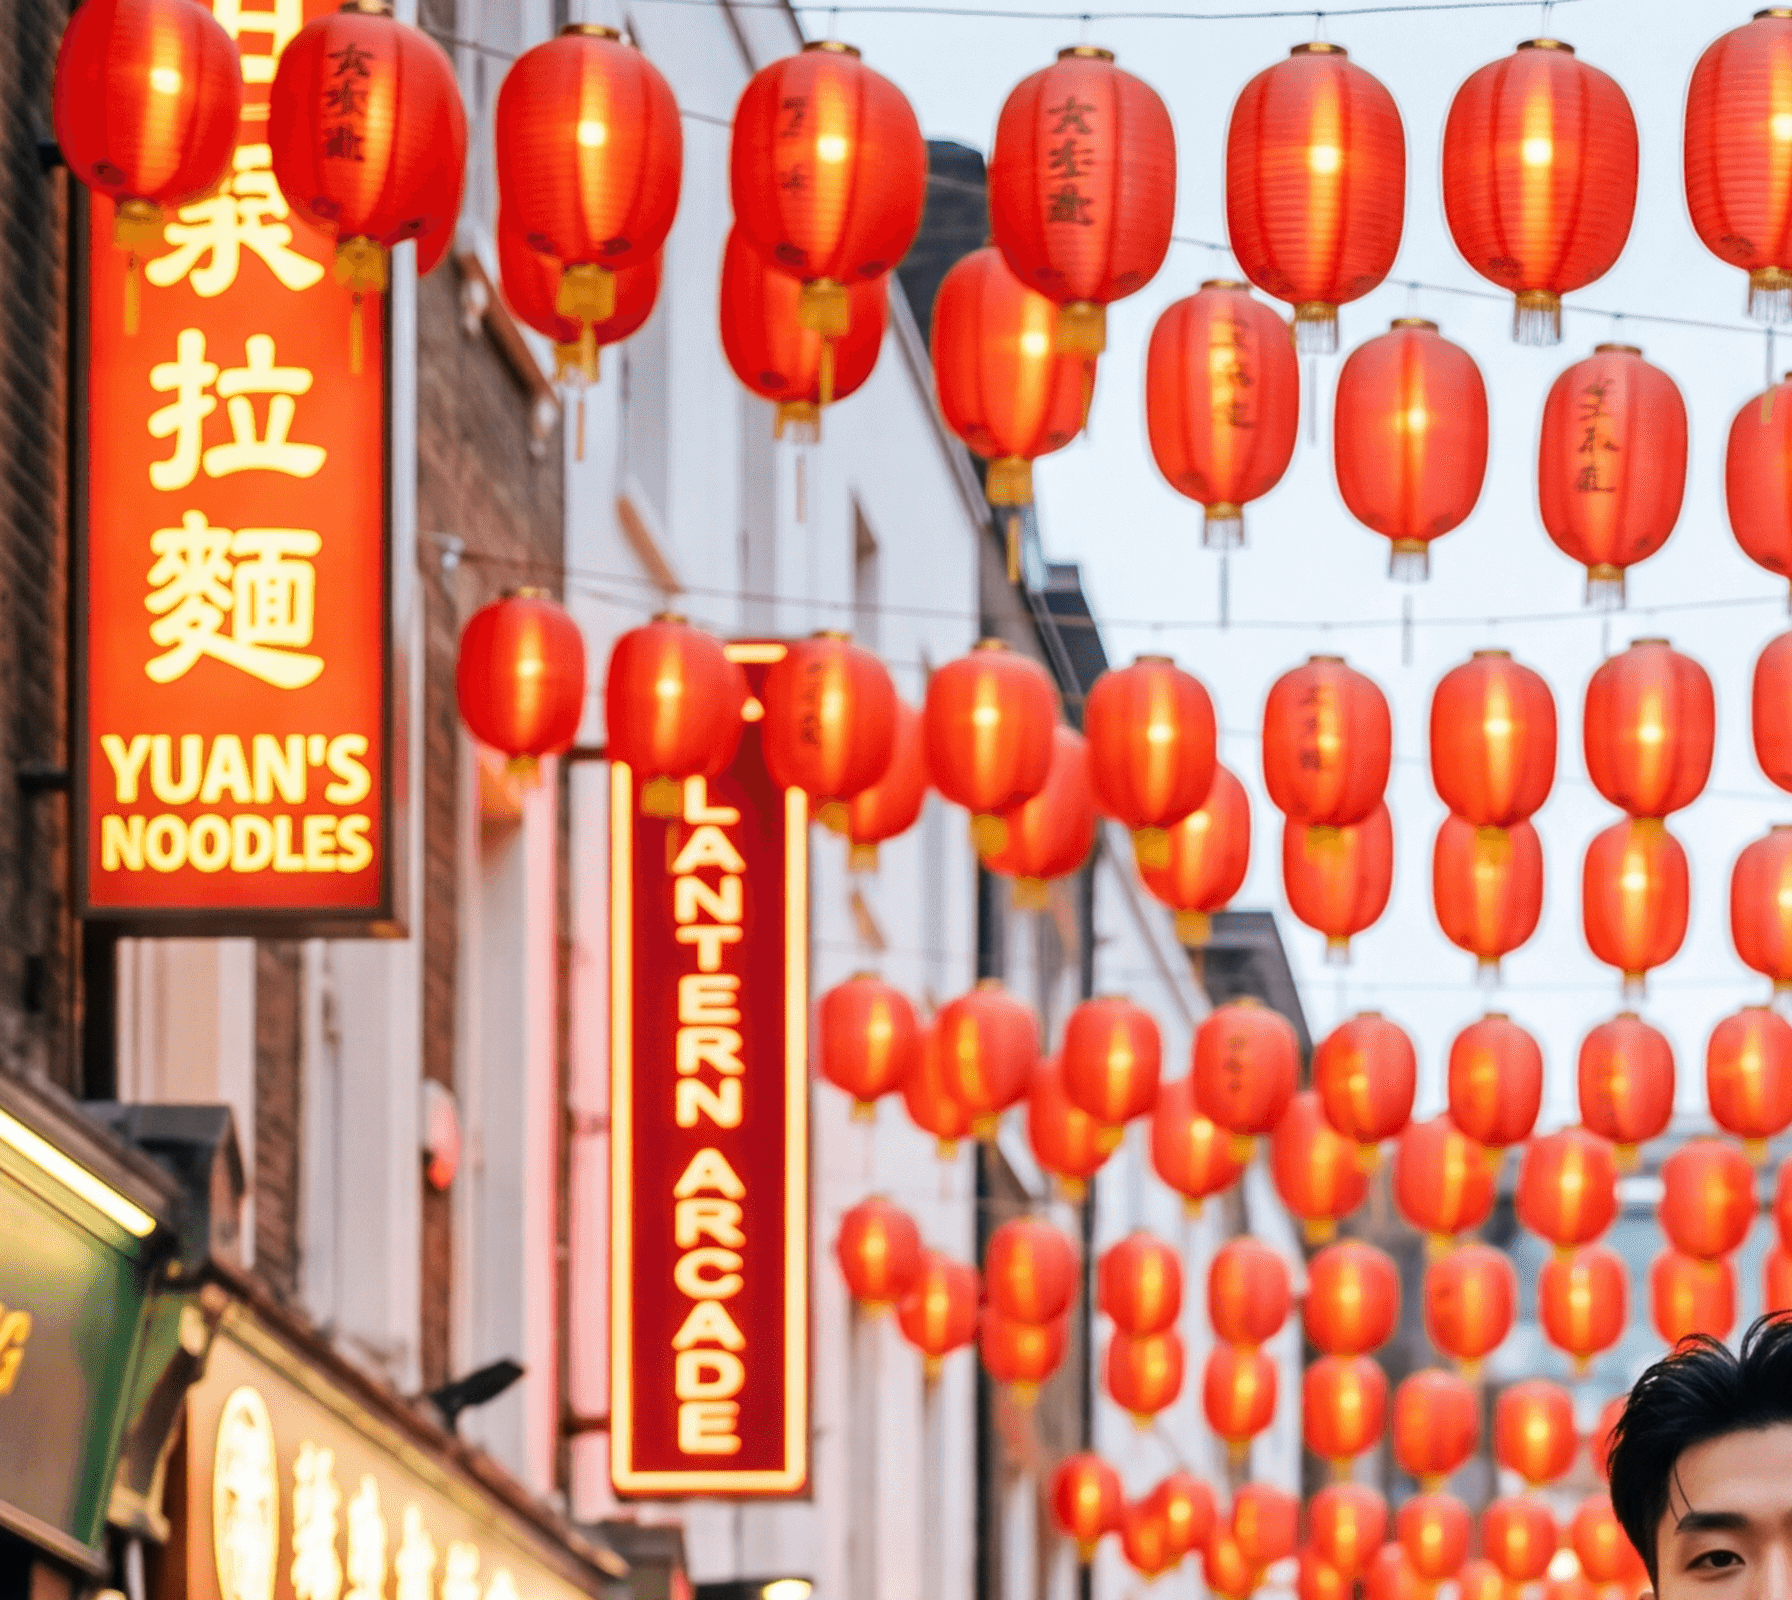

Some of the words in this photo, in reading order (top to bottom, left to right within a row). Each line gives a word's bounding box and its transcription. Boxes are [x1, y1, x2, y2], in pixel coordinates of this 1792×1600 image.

[100, 733, 371, 805] YUAN'S
[100, 813, 373, 873] NOODLES
[671, 775, 747, 1128] LANTERN
[671, 1148, 747, 1454] ARCADE
